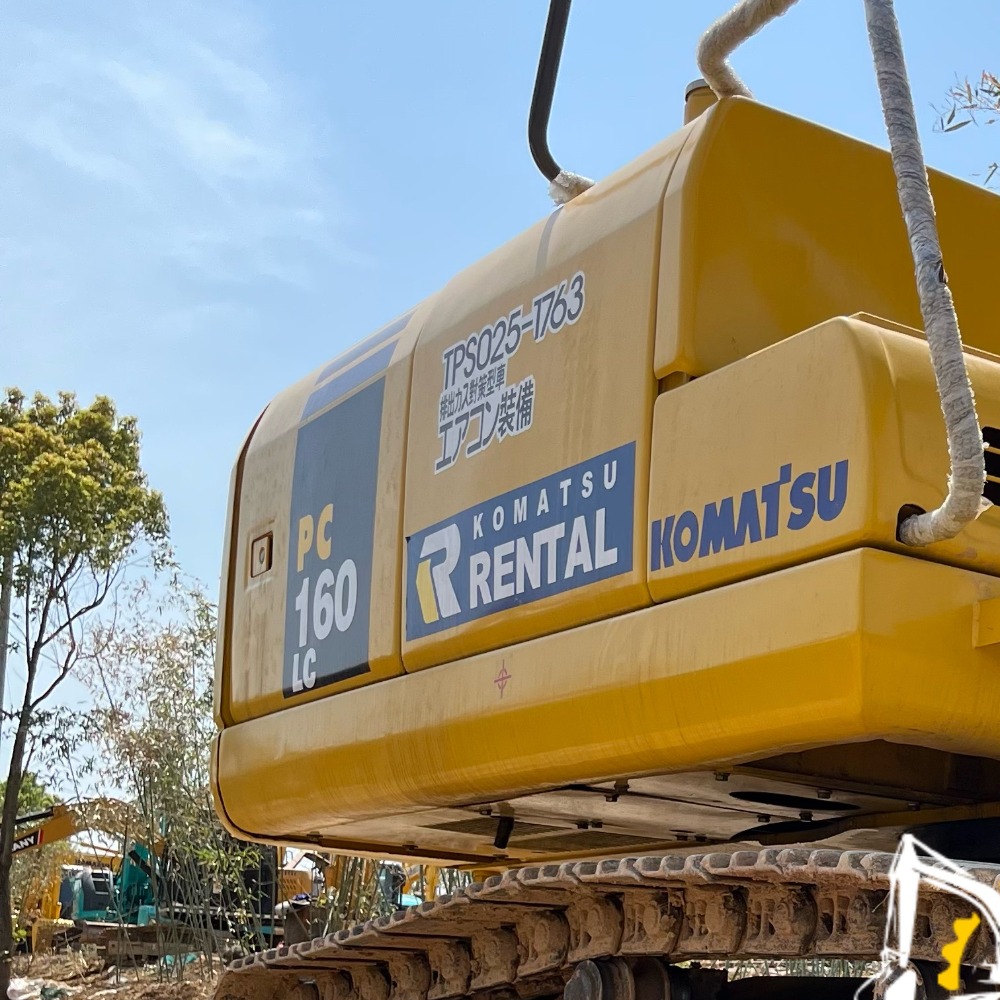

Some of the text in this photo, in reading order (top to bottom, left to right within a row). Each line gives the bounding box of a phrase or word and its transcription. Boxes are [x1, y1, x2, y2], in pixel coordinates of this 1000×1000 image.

[444, 275, 583, 390] TPS025-1763
[297, 504, 333, 572] PC
[473, 460, 617, 540] KOMATSU
[651, 459, 849, 571] KOMATSU
[470, 508, 618, 609] RENTAL
[296, 559, 357, 647] 160
[292, 648, 316, 692] LC
[11, 835, 34, 852] ANY
